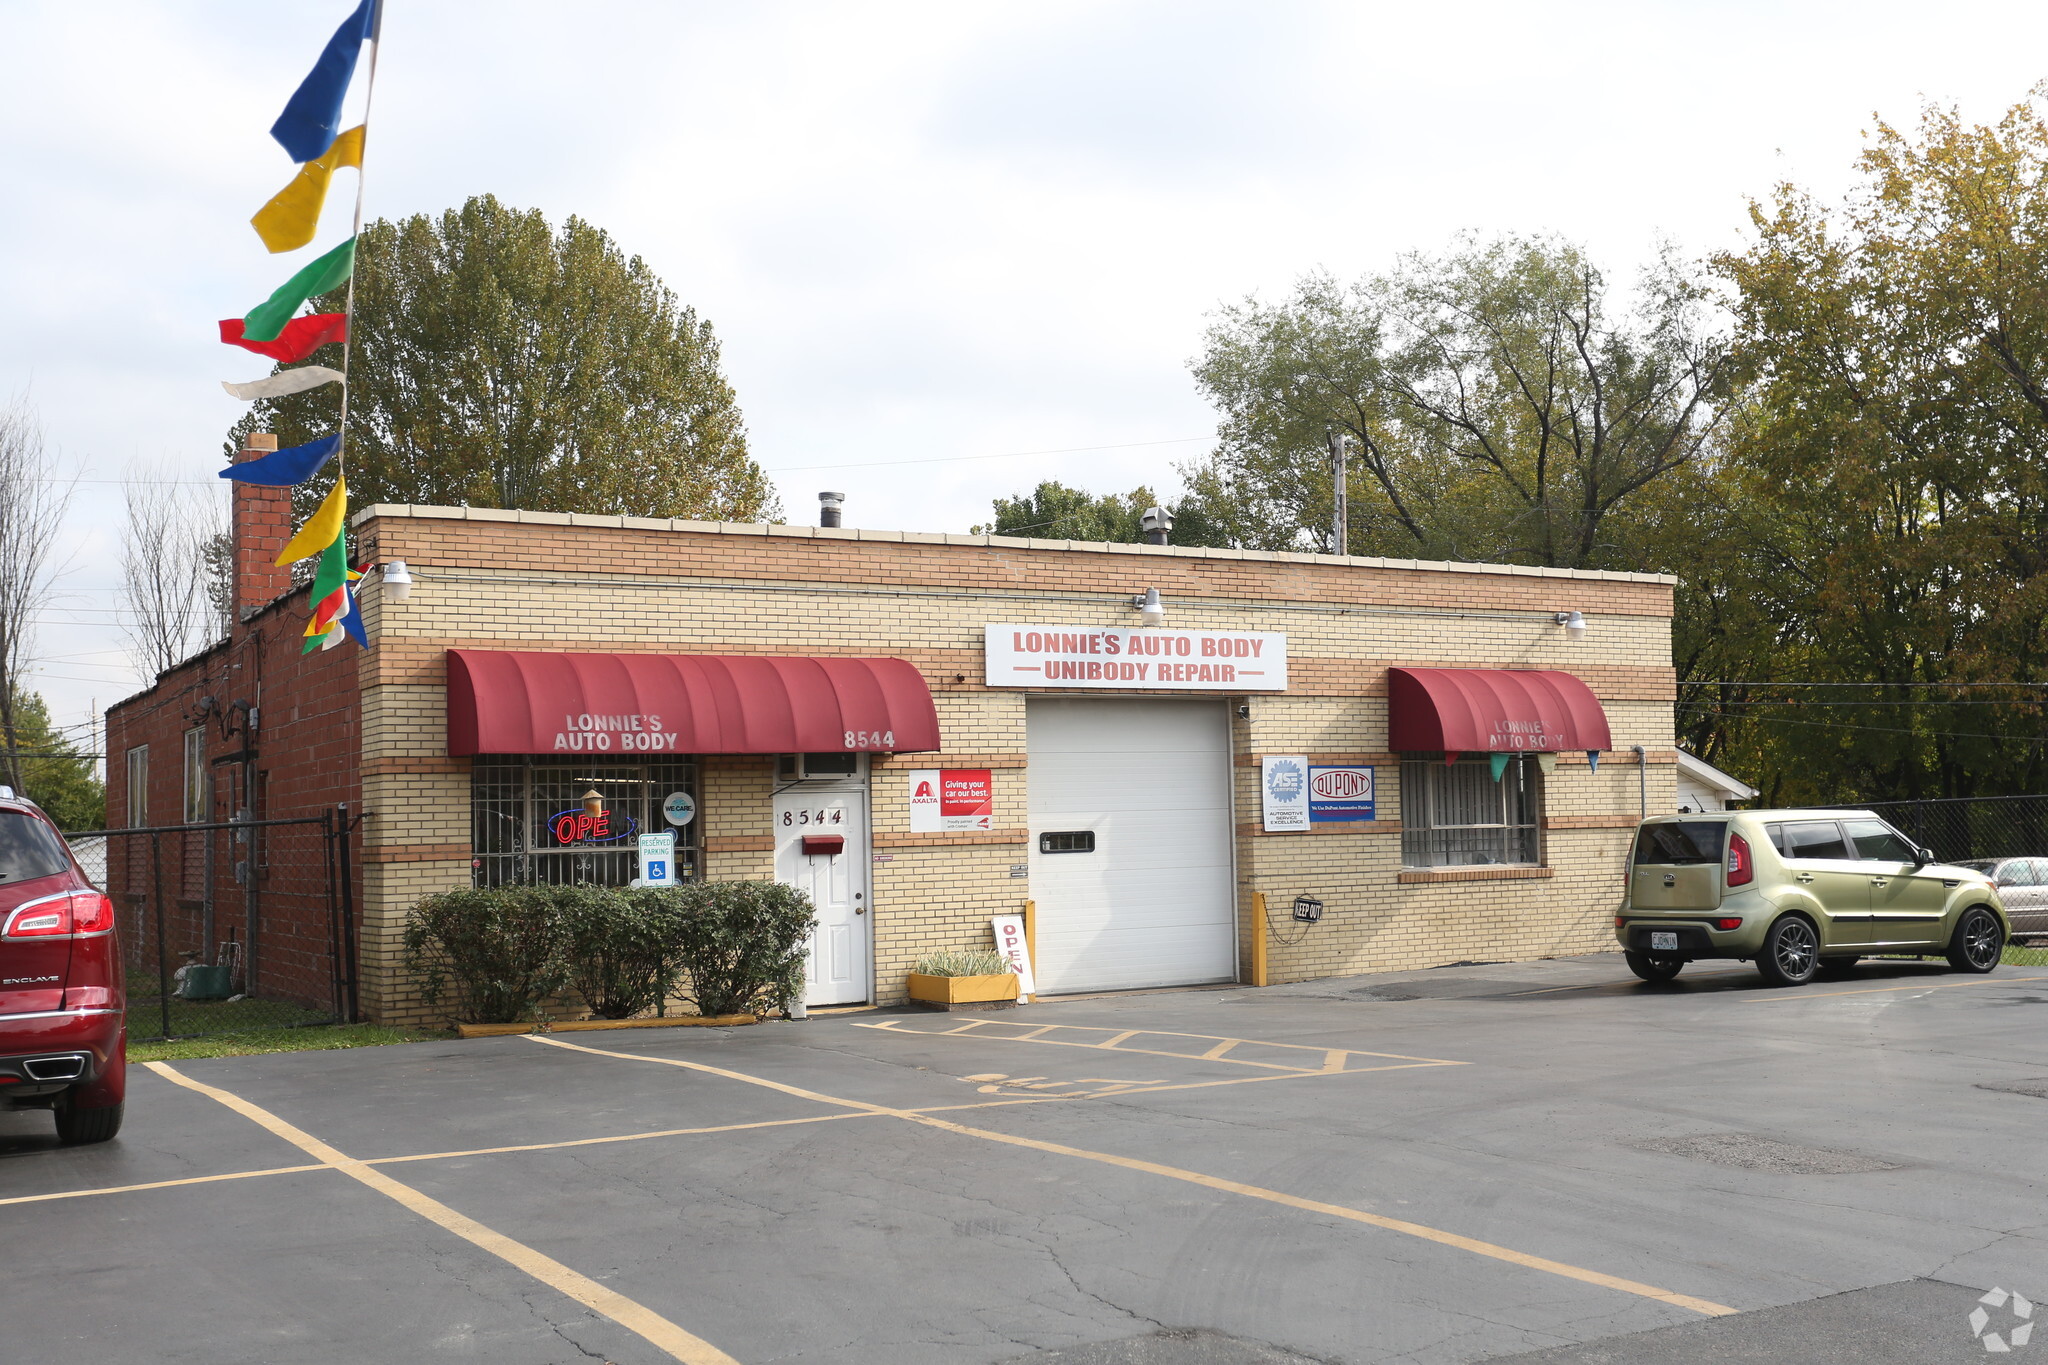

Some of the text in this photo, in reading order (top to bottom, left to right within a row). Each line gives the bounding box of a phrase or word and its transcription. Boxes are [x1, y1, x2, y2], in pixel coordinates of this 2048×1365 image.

[1013, 631, 1264, 658] LONNIE'S AUTO BODY
[1044, 660, 1236, 682] UNIBODY REPAIR
[566, 713, 663, 732] LONNIE'S
[553, 732, 678, 751] AUTO BODY
[844, 730, 896, 749] 8544
[945, 780, 985, 790] Giving your
[1271, 772, 1298, 788] ASE
[945, 790, 956, 798] car
[971, 789, 989, 797] best.
[783, 809, 842, 827] 8544
[641, 838, 671, 847] RESERVED
[643, 847, 670, 856] PARKING
[1309, 903, 1321, 919] OUT
[1003, 924, 1024, 974] OPEN
[2, 975, 60, 985] ENCLAVE
